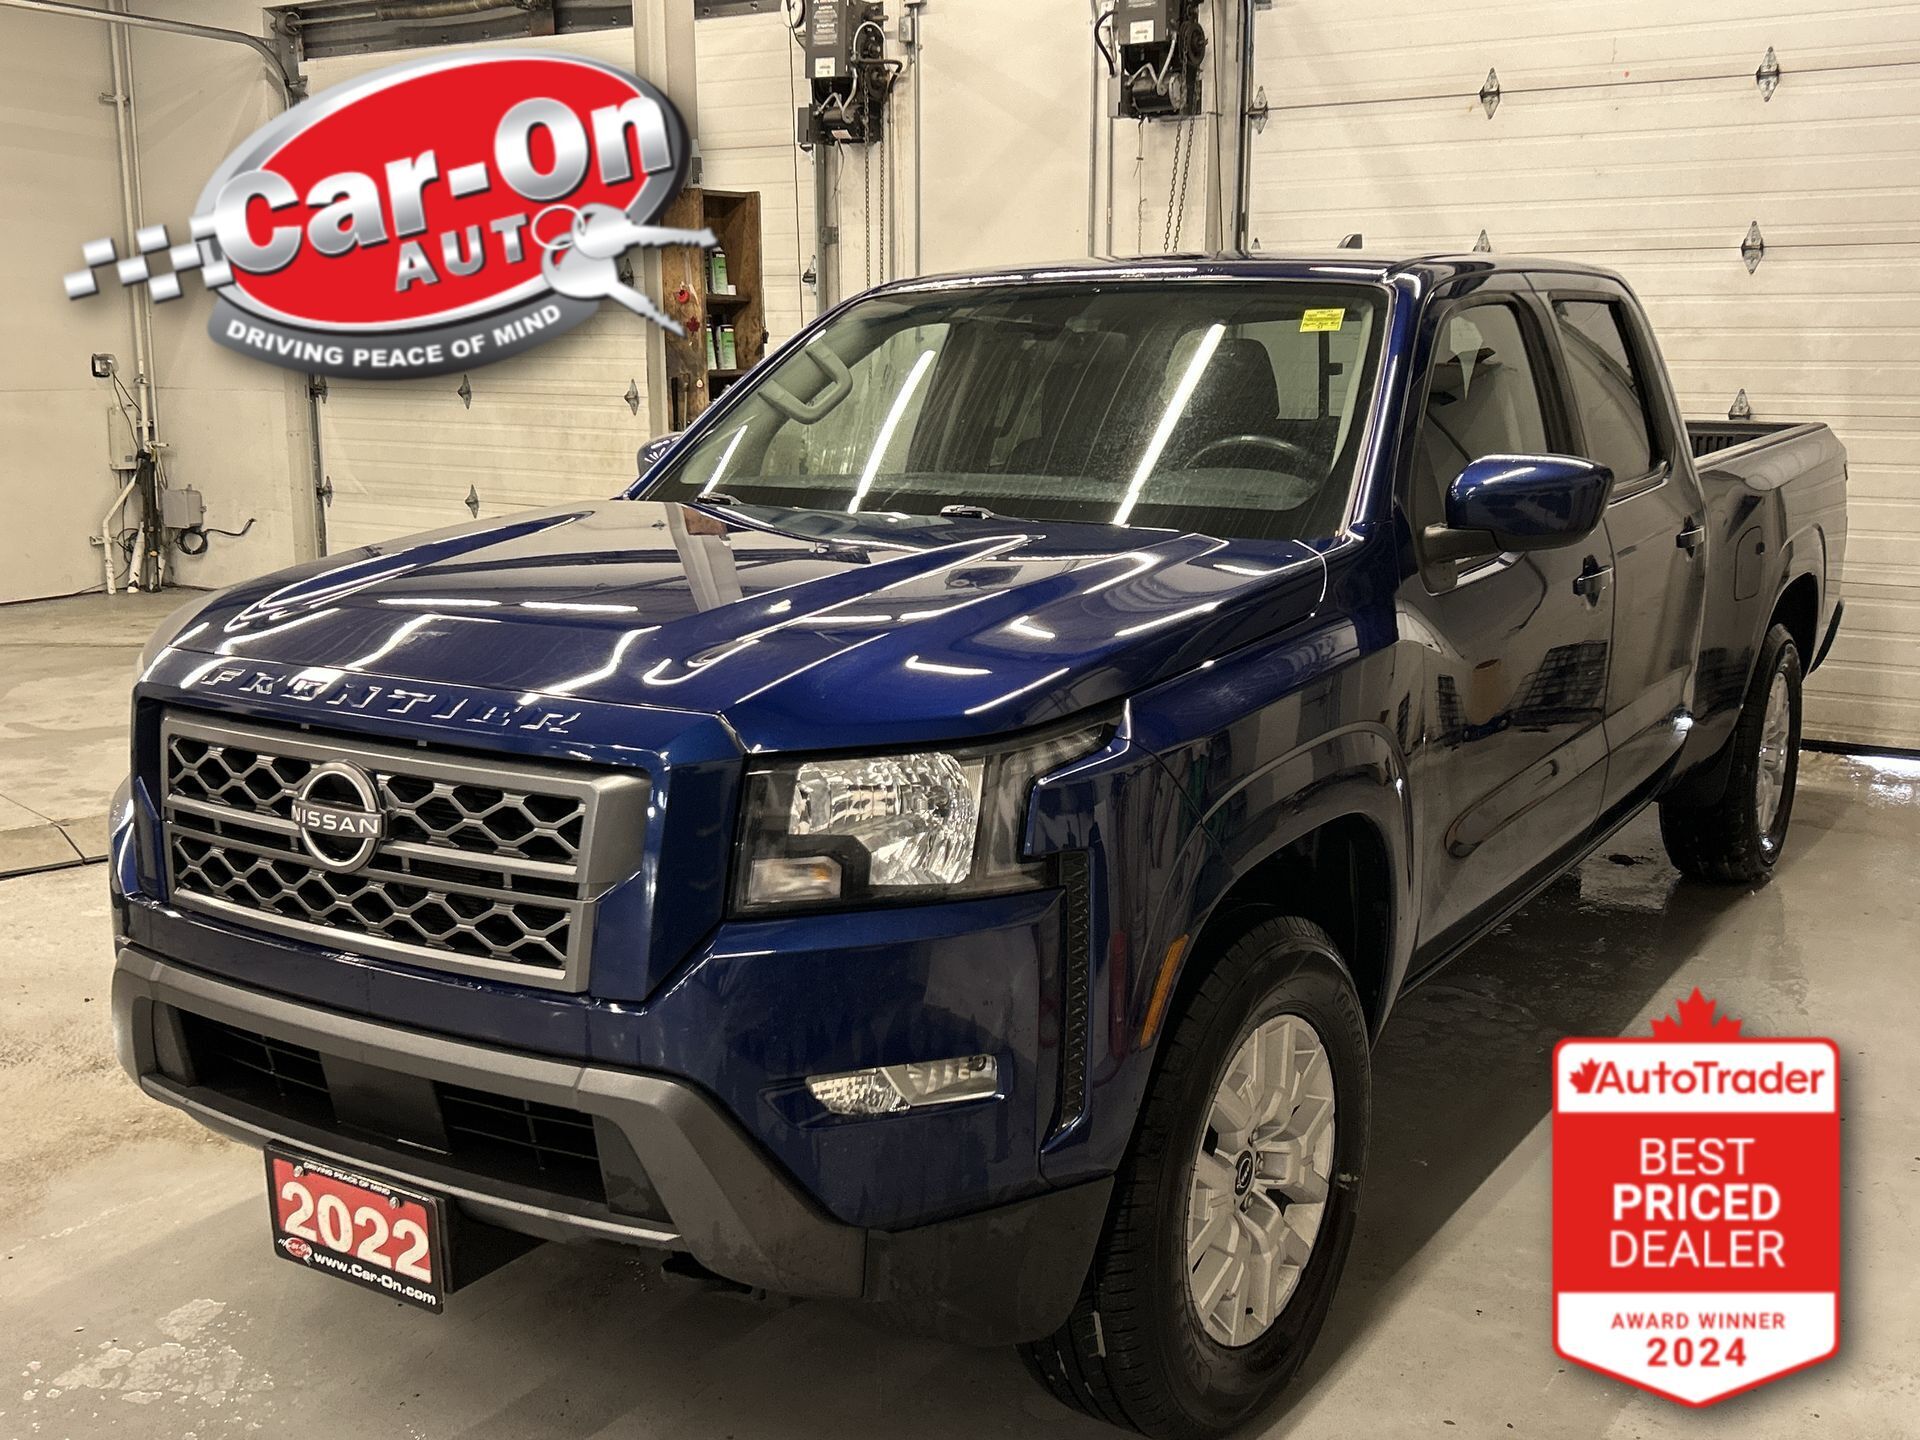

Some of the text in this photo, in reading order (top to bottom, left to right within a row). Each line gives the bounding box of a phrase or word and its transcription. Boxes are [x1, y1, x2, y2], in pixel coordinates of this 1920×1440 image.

[201, 666, 582, 734] FRONTIER
[291, 804, 381, 835] NISSAN
[281, 1181, 432, 1284] 2022
[314, 1252, 437, 1305] www.Car-On.com
